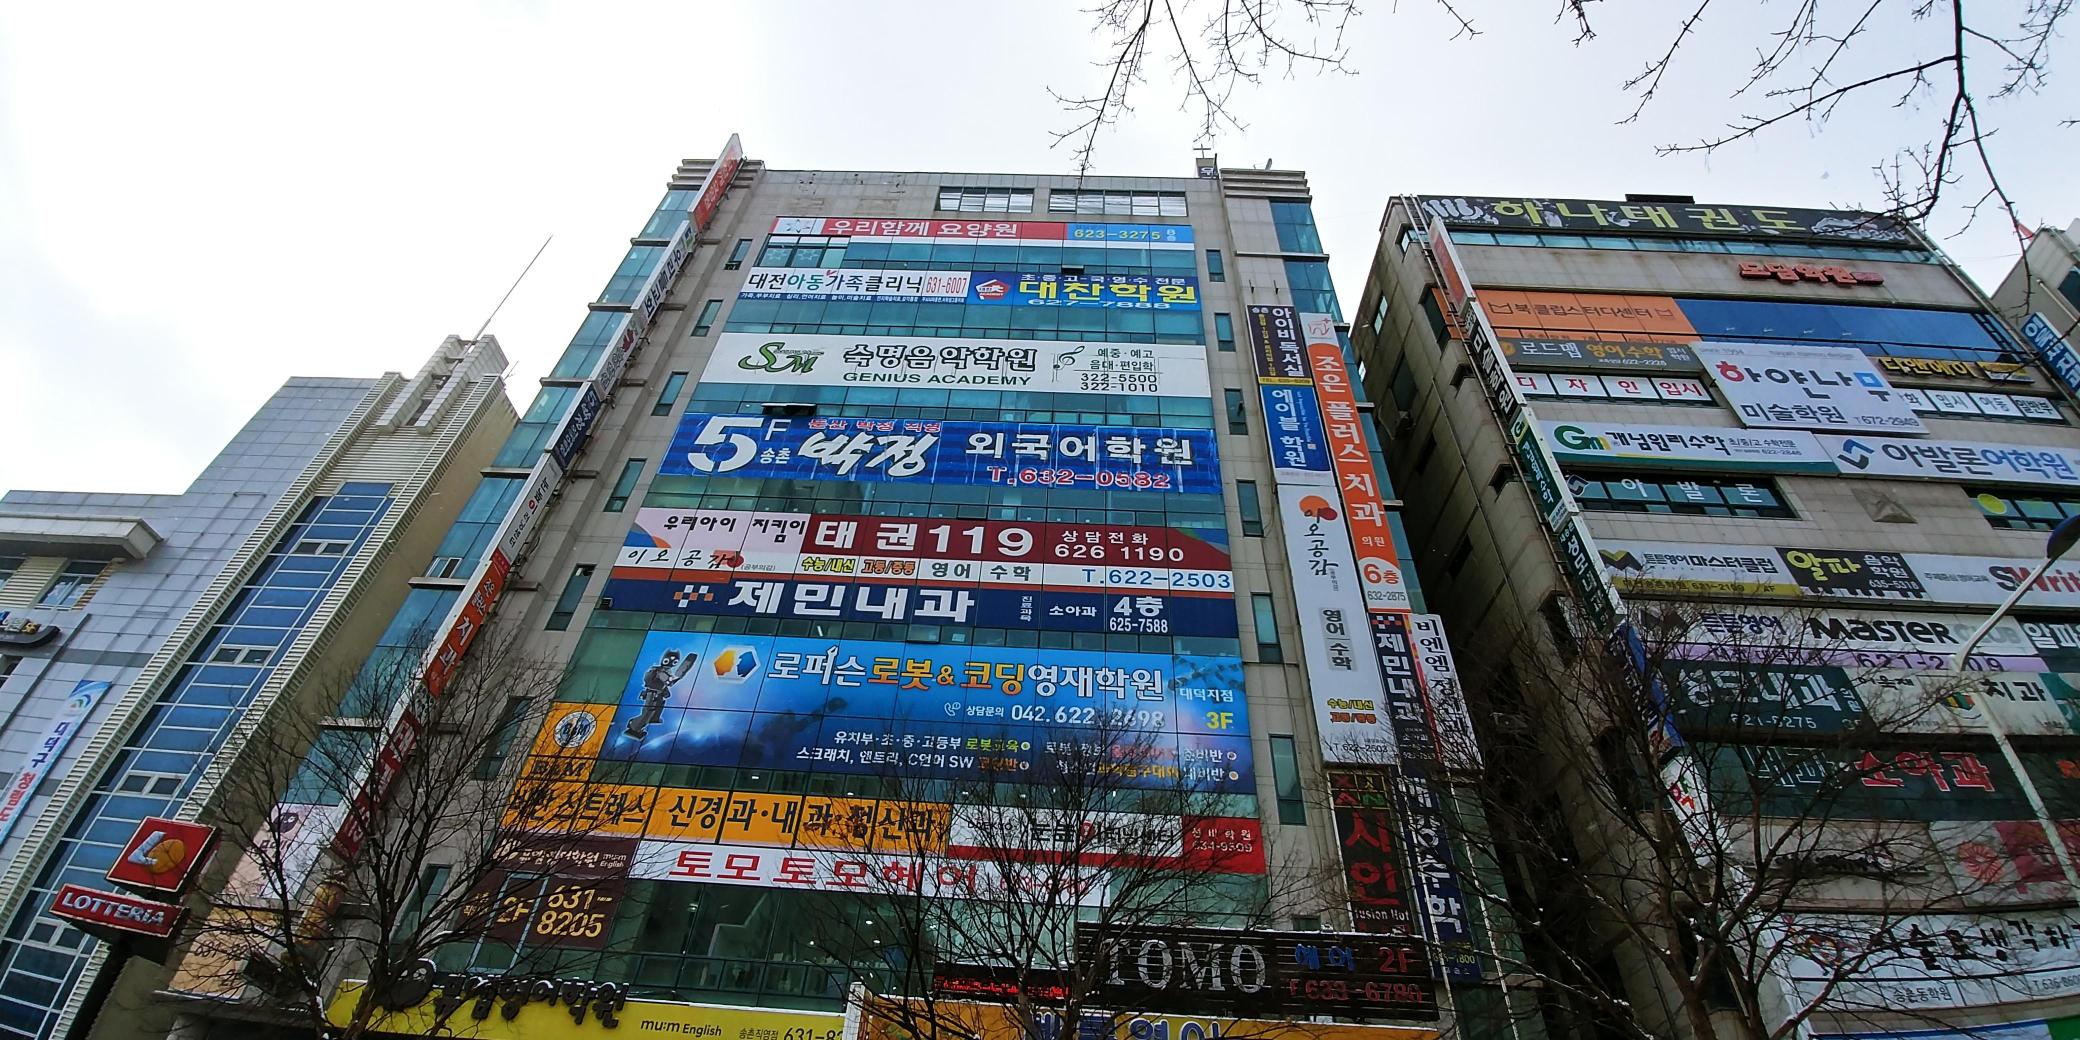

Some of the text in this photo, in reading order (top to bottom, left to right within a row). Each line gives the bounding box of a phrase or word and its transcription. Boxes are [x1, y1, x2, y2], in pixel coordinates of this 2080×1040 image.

[1494, 200, 1806, 232] 하나태권도
[829, 220, 1017, 238] 우리함께 요양원
[1074, 228, 1161, 240] 623-3275
[748, 273, 923, 293] 대전아동가족클리닉
[926, 276, 967, 295] 631-6007
[1019, 281, 1198, 304] 대찬학원
[1028, 298, 1171, 309] 627-7888
[1272, 307, 1305, 377] 아이비독서실
[1520, 341, 1664, 360] 로드맵 영어수학
[842, 344, 1039, 373] 숙명음악학원
[843, 373, 1031, 386] GENIUS ACADEMY
[1080, 373, 1157, 383] 322-5500
[1080, 382, 1158, 393] 322-1010
[1740, 402, 1849, 424] 미술학원
[965, 431, 1193, 466] 외국어학원
[1606, 430, 1732, 456] 개념원리수학
[760, 447, 790, 465] 송촌
[1881, 443, 2080, 481] 아발론어학원
[663, 515, 806, 544] 우리아이 지킴이
[1061, 529, 1149, 545] 상담전화
[1054, 543, 1185, 562] 626 1190
[1863, 554, 1900, 567] 음악
[801, 556, 1032, 582] 수능/내신 고등/중등 영어 수학
[1363, 563, 1399, 585] 6층
[1786, 550, 1862, 582] 알파
[1870, 566, 1909, 580] 학원
[728, 580, 975, 623] 제민내과
[1049, 604, 1098, 618] 소아과
[1113, 595, 1164, 617] 4층
[1110, 617, 1169, 634] 625-7588
[1322, 608, 1345, 636] 영어
[1330, 642, 1352, 671] 수학
[1857, 653, 2005, 672] 621-209
[1376, 633, 1426, 724] 제민내과
[966, 705, 1004, 718] 상담문의
[1205, 712, 1234, 729] 3F
[949, 755, 975, 769] SW
[1853, 751, 1996, 793] 소아과
[61, 889, 166, 927] LOTTERIA
[536, 911, 606, 938] 8205
[1101, 937, 1266, 994] TOMO
[682, 1023, 722, 1038] English
